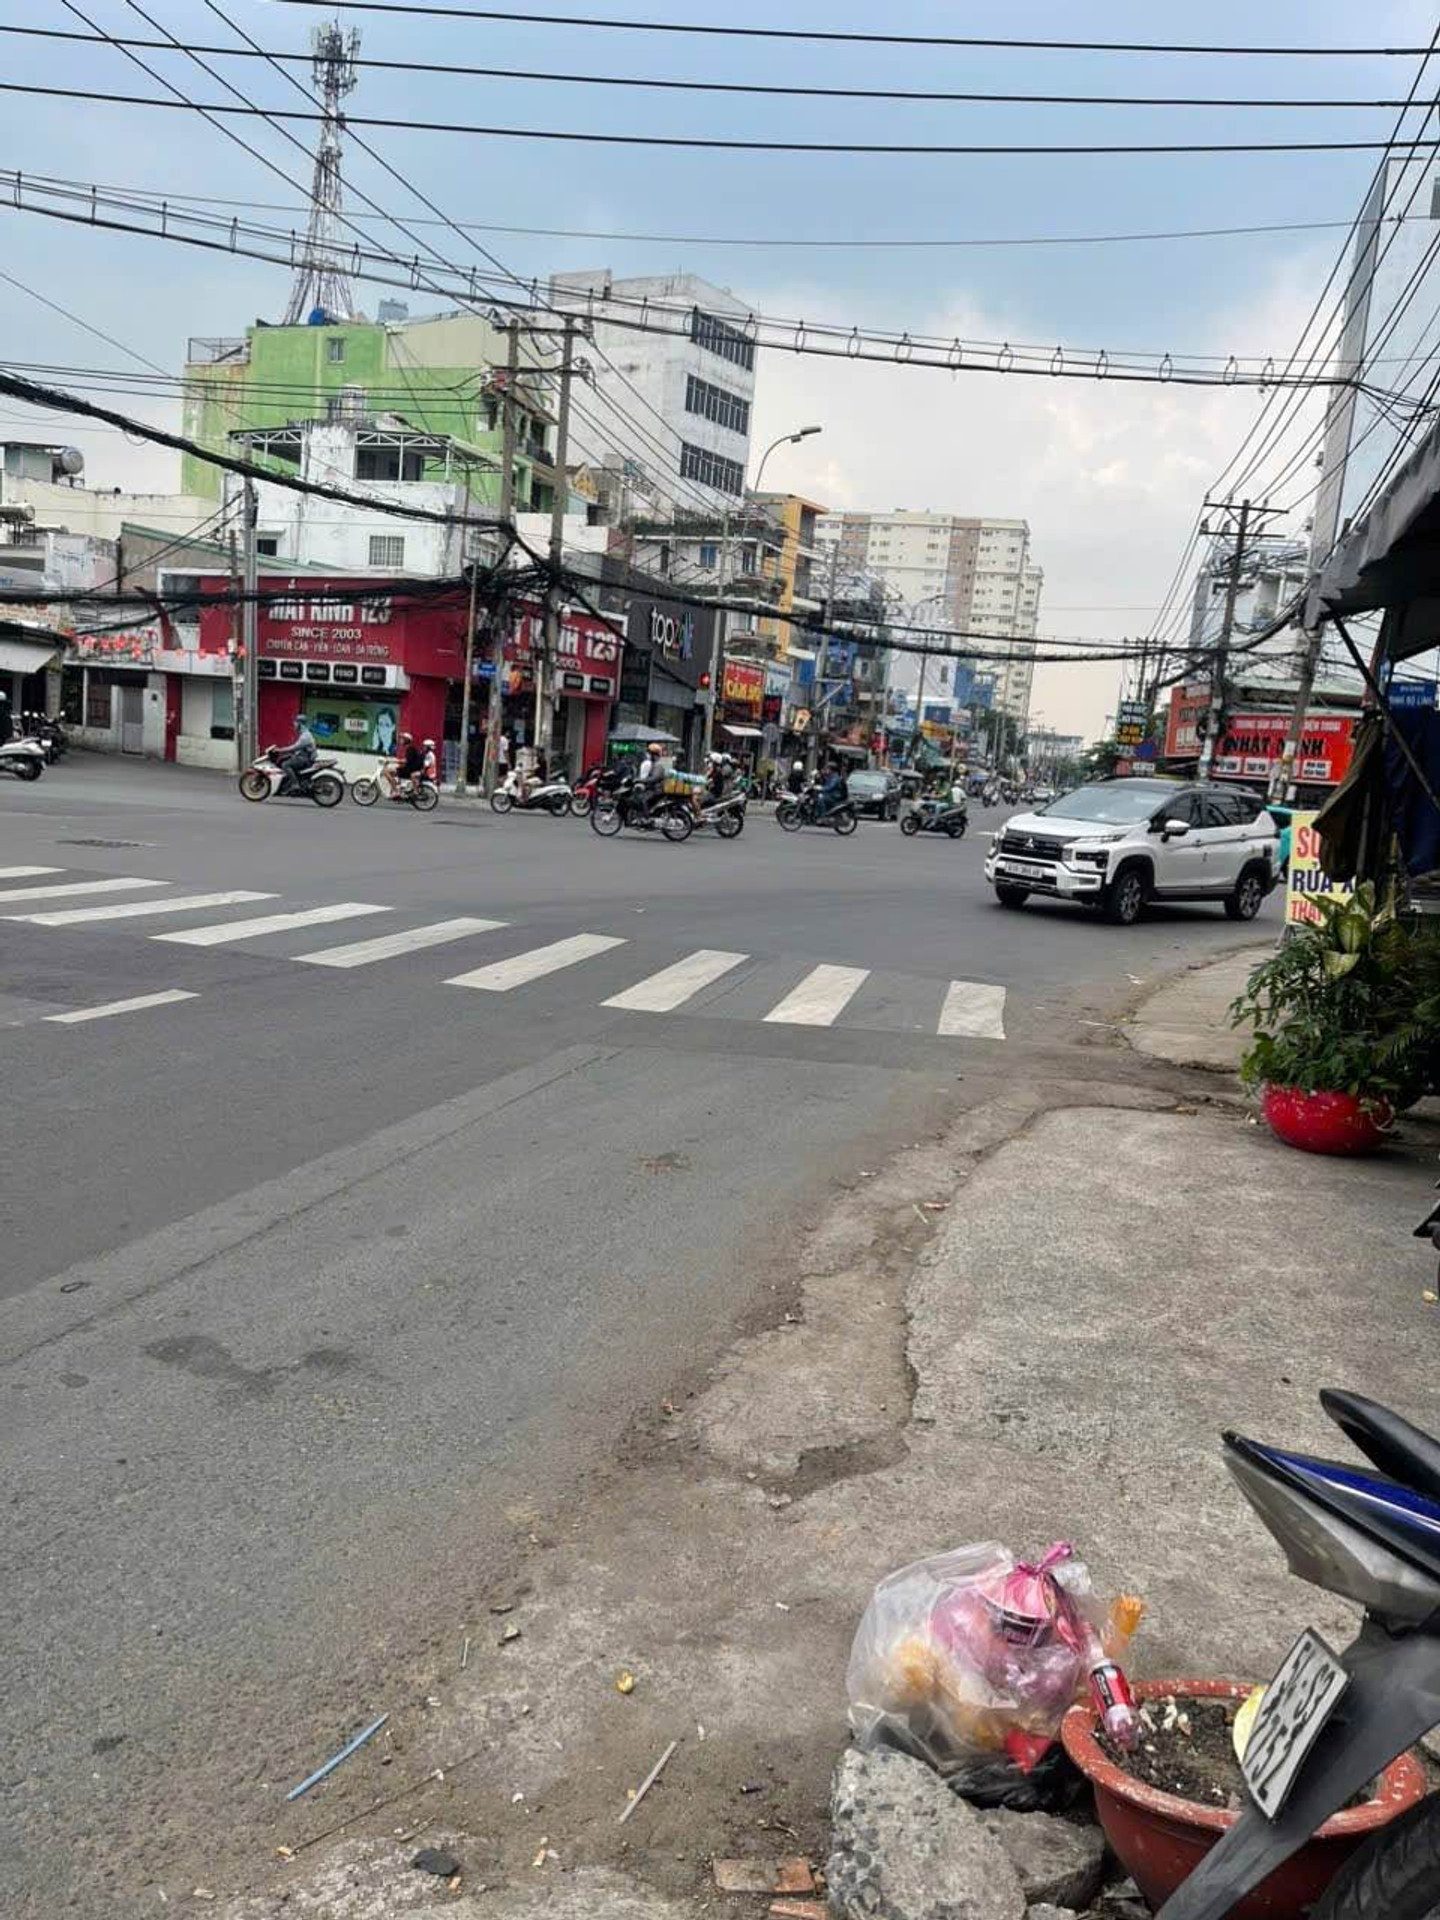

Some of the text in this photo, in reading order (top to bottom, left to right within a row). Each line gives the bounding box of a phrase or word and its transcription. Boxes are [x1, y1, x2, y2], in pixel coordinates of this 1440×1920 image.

[291, 626, 361, 639] SINCE 2003
[585, 629, 618, 661] 123
